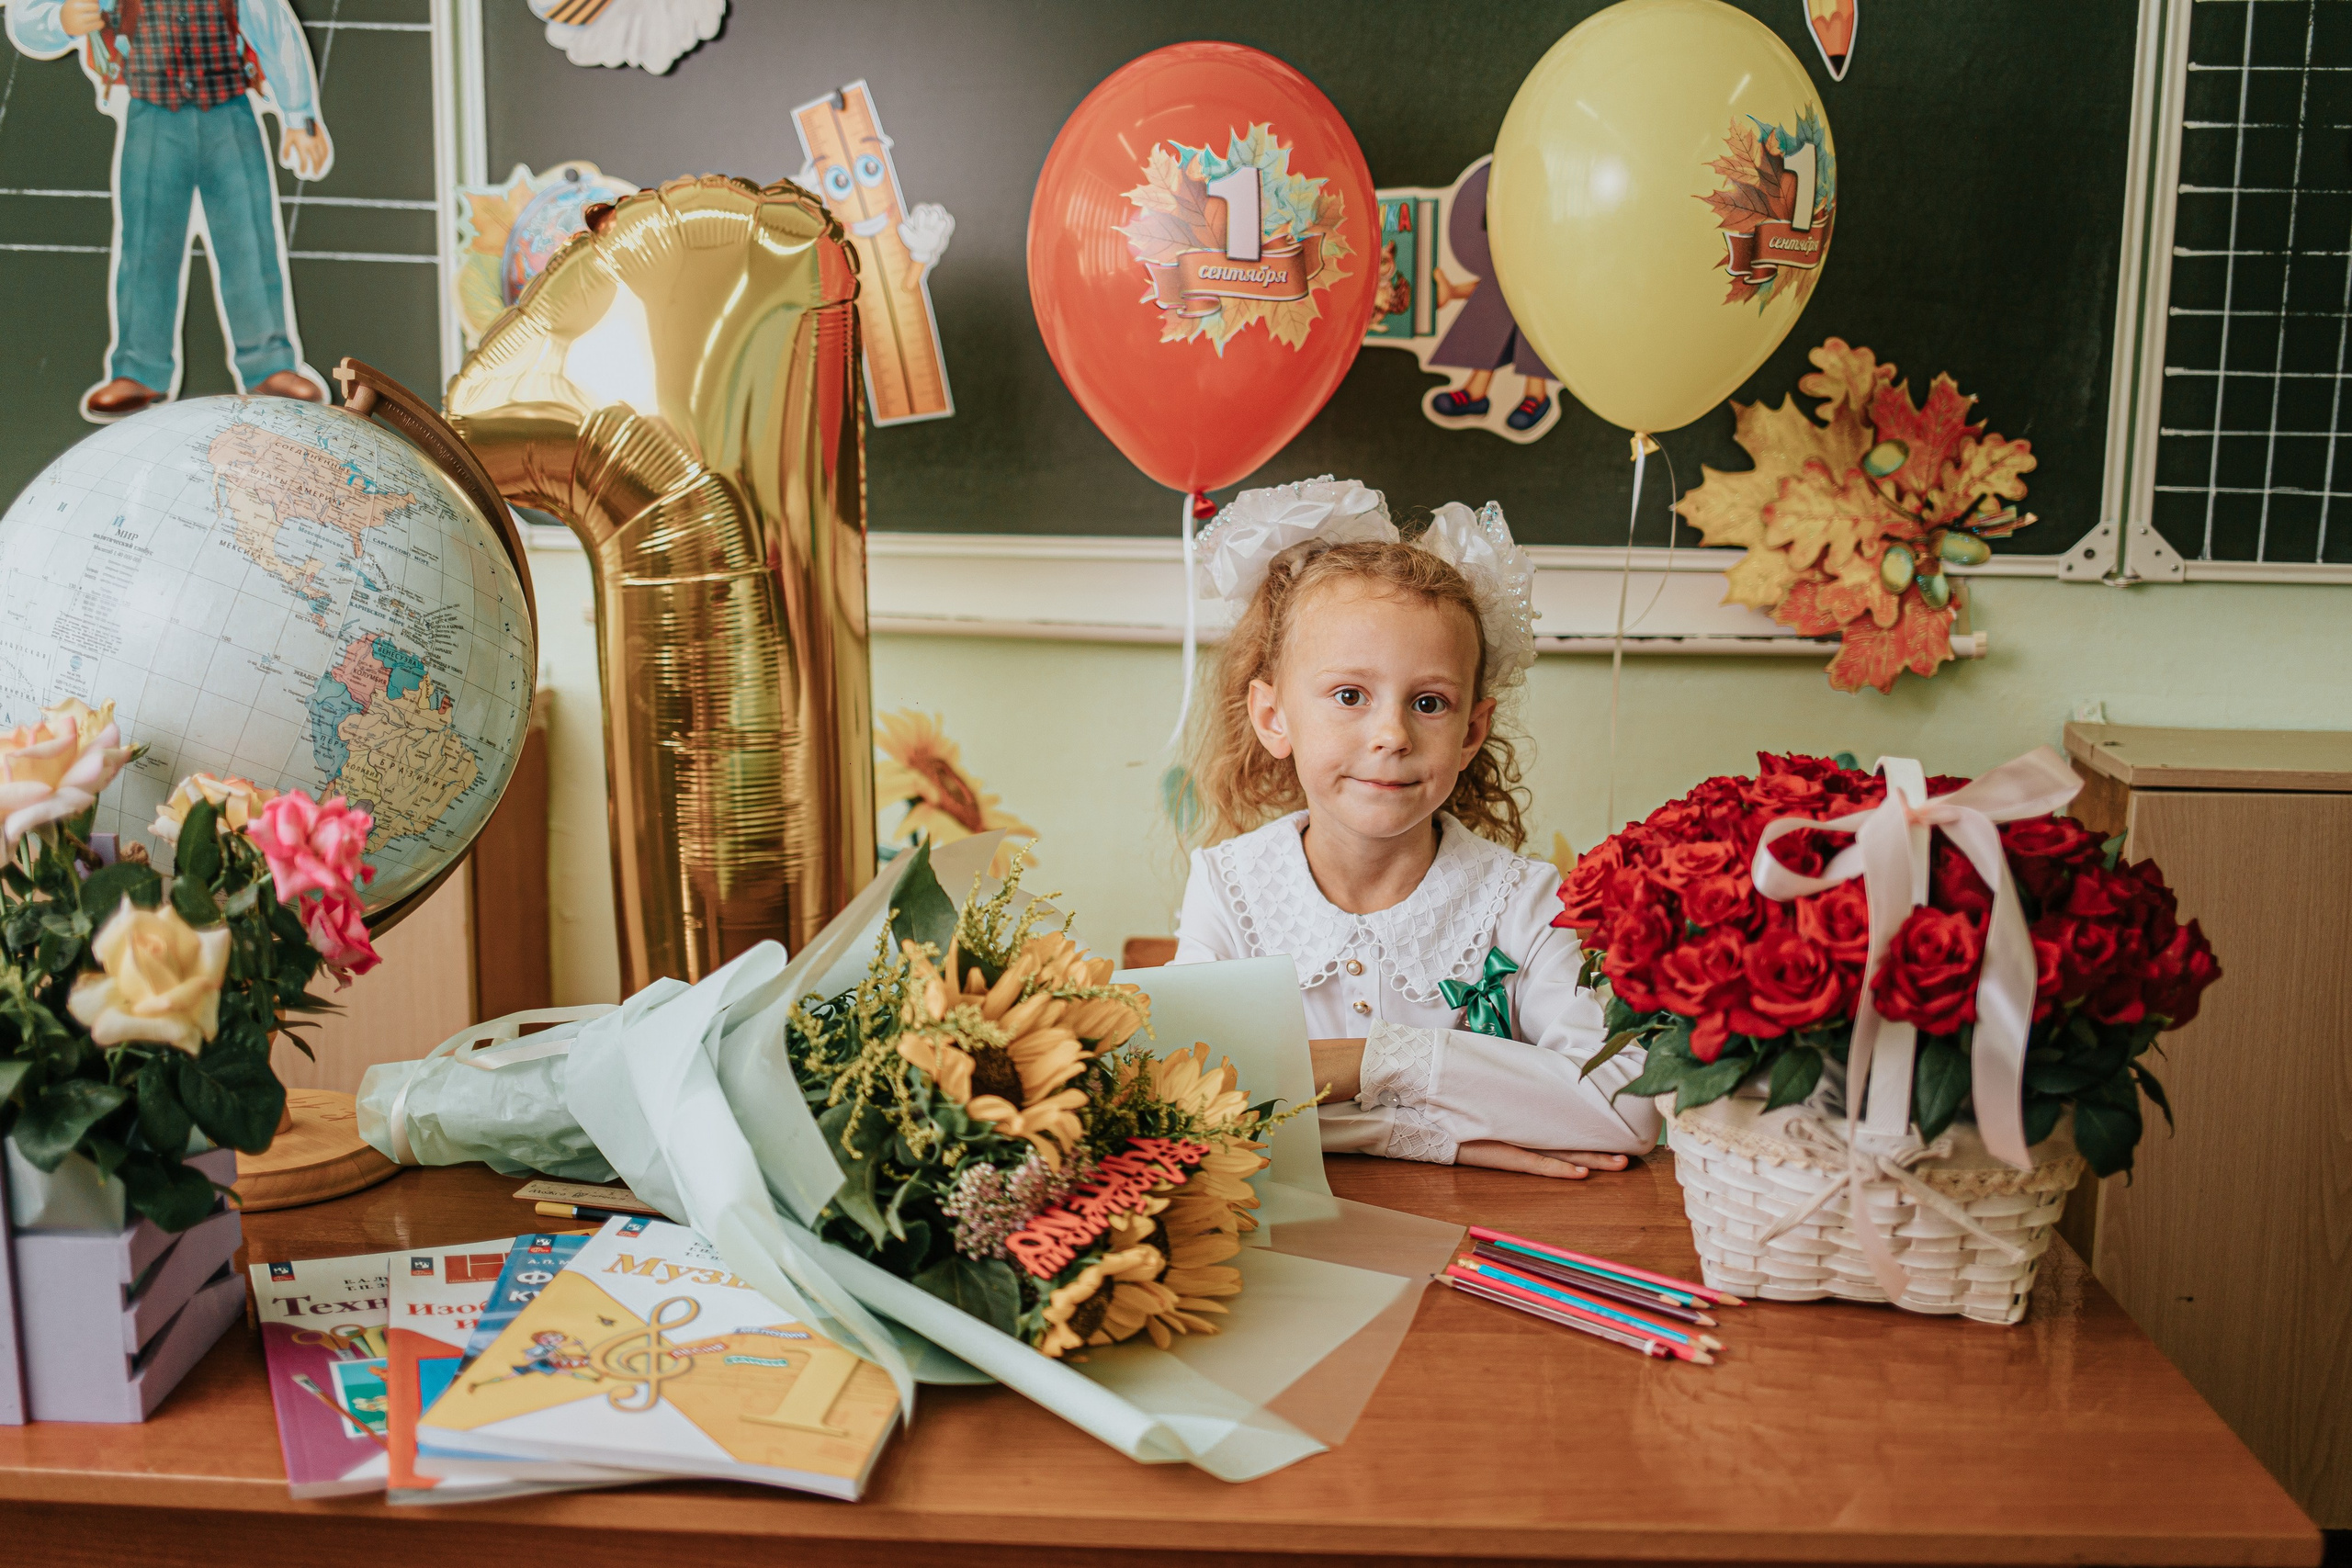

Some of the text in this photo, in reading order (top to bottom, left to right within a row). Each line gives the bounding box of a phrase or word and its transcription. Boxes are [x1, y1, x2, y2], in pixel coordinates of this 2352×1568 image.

[1783, 141, 1816, 231] 1
[1207, 164, 1262, 262] 1
[1769, 235, 1819, 256] сентября
[1197, 264, 1288, 288] сентября
[250, 467, 346, 508] ШТАТЫ АМЕРИКИ
[115, 527, 140, 542] МИР
[219, 539, 262, 561] МЕКСИКА
[372, 537, 412, 558] САРГАССОВО
[413, 555, 430, 566] МОРЕ
[378, 645, 417, 668] ВЕНЕСУЭЛА
[353, 668, 387, 686] КОЛУМБИЯ
[320, 735, 346, 749] ПЕРУ
[345, 761, 379, 779] БОЛИВИЯ
[379, 757, 446, 791] БРАЗИЛИЯ
[516, 1269, 553, 1285] Ф
[272, 1295, 390, 1317] Техн
[738, 1346, 861, 1438] 1
